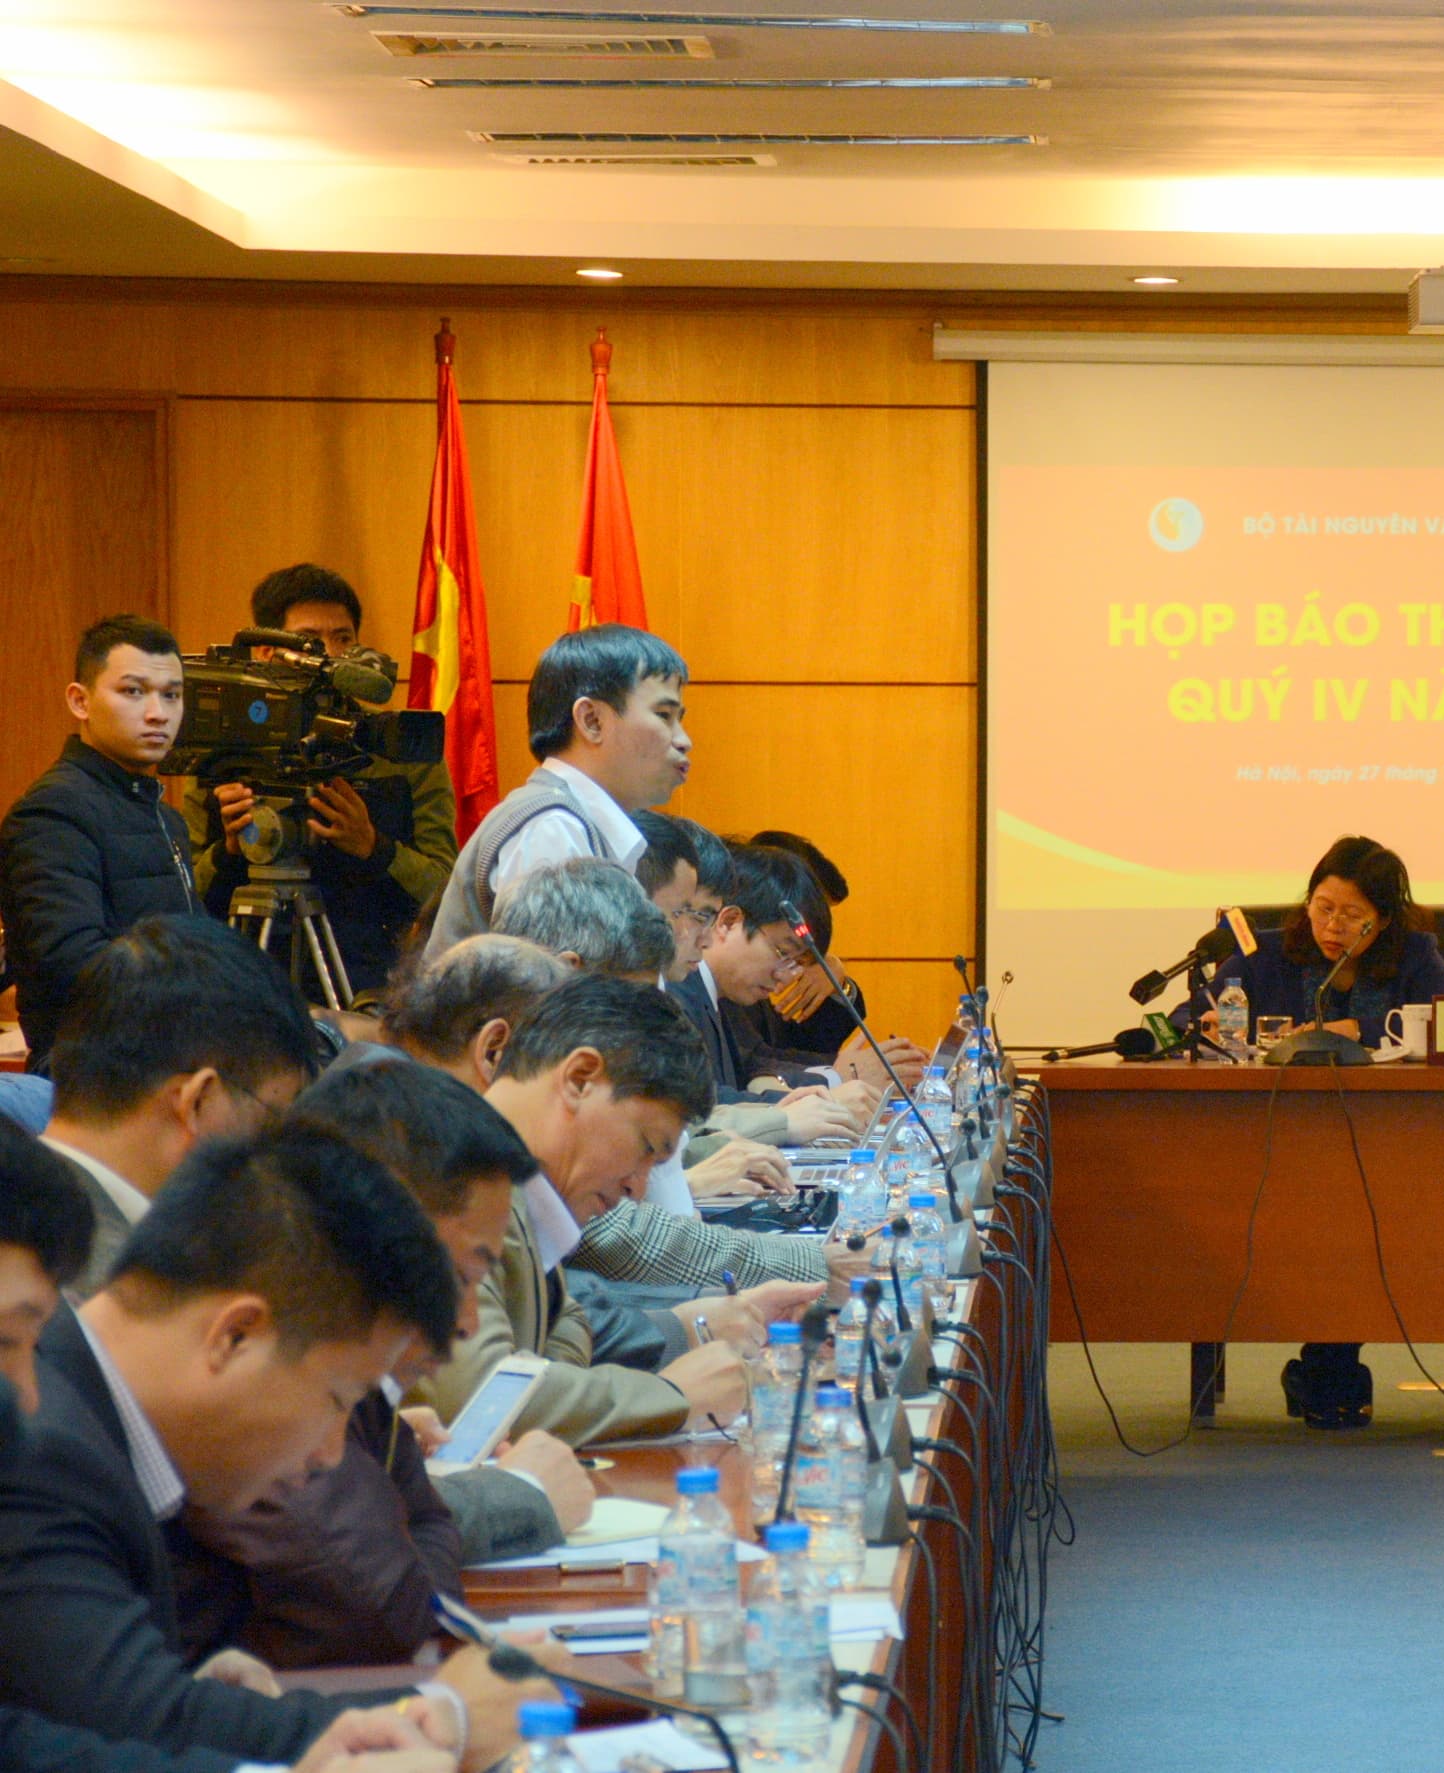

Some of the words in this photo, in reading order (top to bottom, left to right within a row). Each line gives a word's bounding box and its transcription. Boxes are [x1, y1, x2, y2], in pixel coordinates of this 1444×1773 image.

[1243, 512, 1276, 539] BỘ
[1281, 512, 1318, 534] TÀI
[1324, 512, 1418, 535] NGUYÊN
[1109, 602, 1236, 660] HỌP
[1255, 590, 1381, 647] BÁO
[1167, 664, 1293, 723] QUÝ
[1313, 677, 1369, 722] IV
[1236, 764, 1264, 781] Hà
[1267, 764, 1302, 784] Nội,
[1307, 764, 1353, 785] ngày
[1358, 764, 1381, 781] 27
[1385, 765, 1438, 785] tháng
